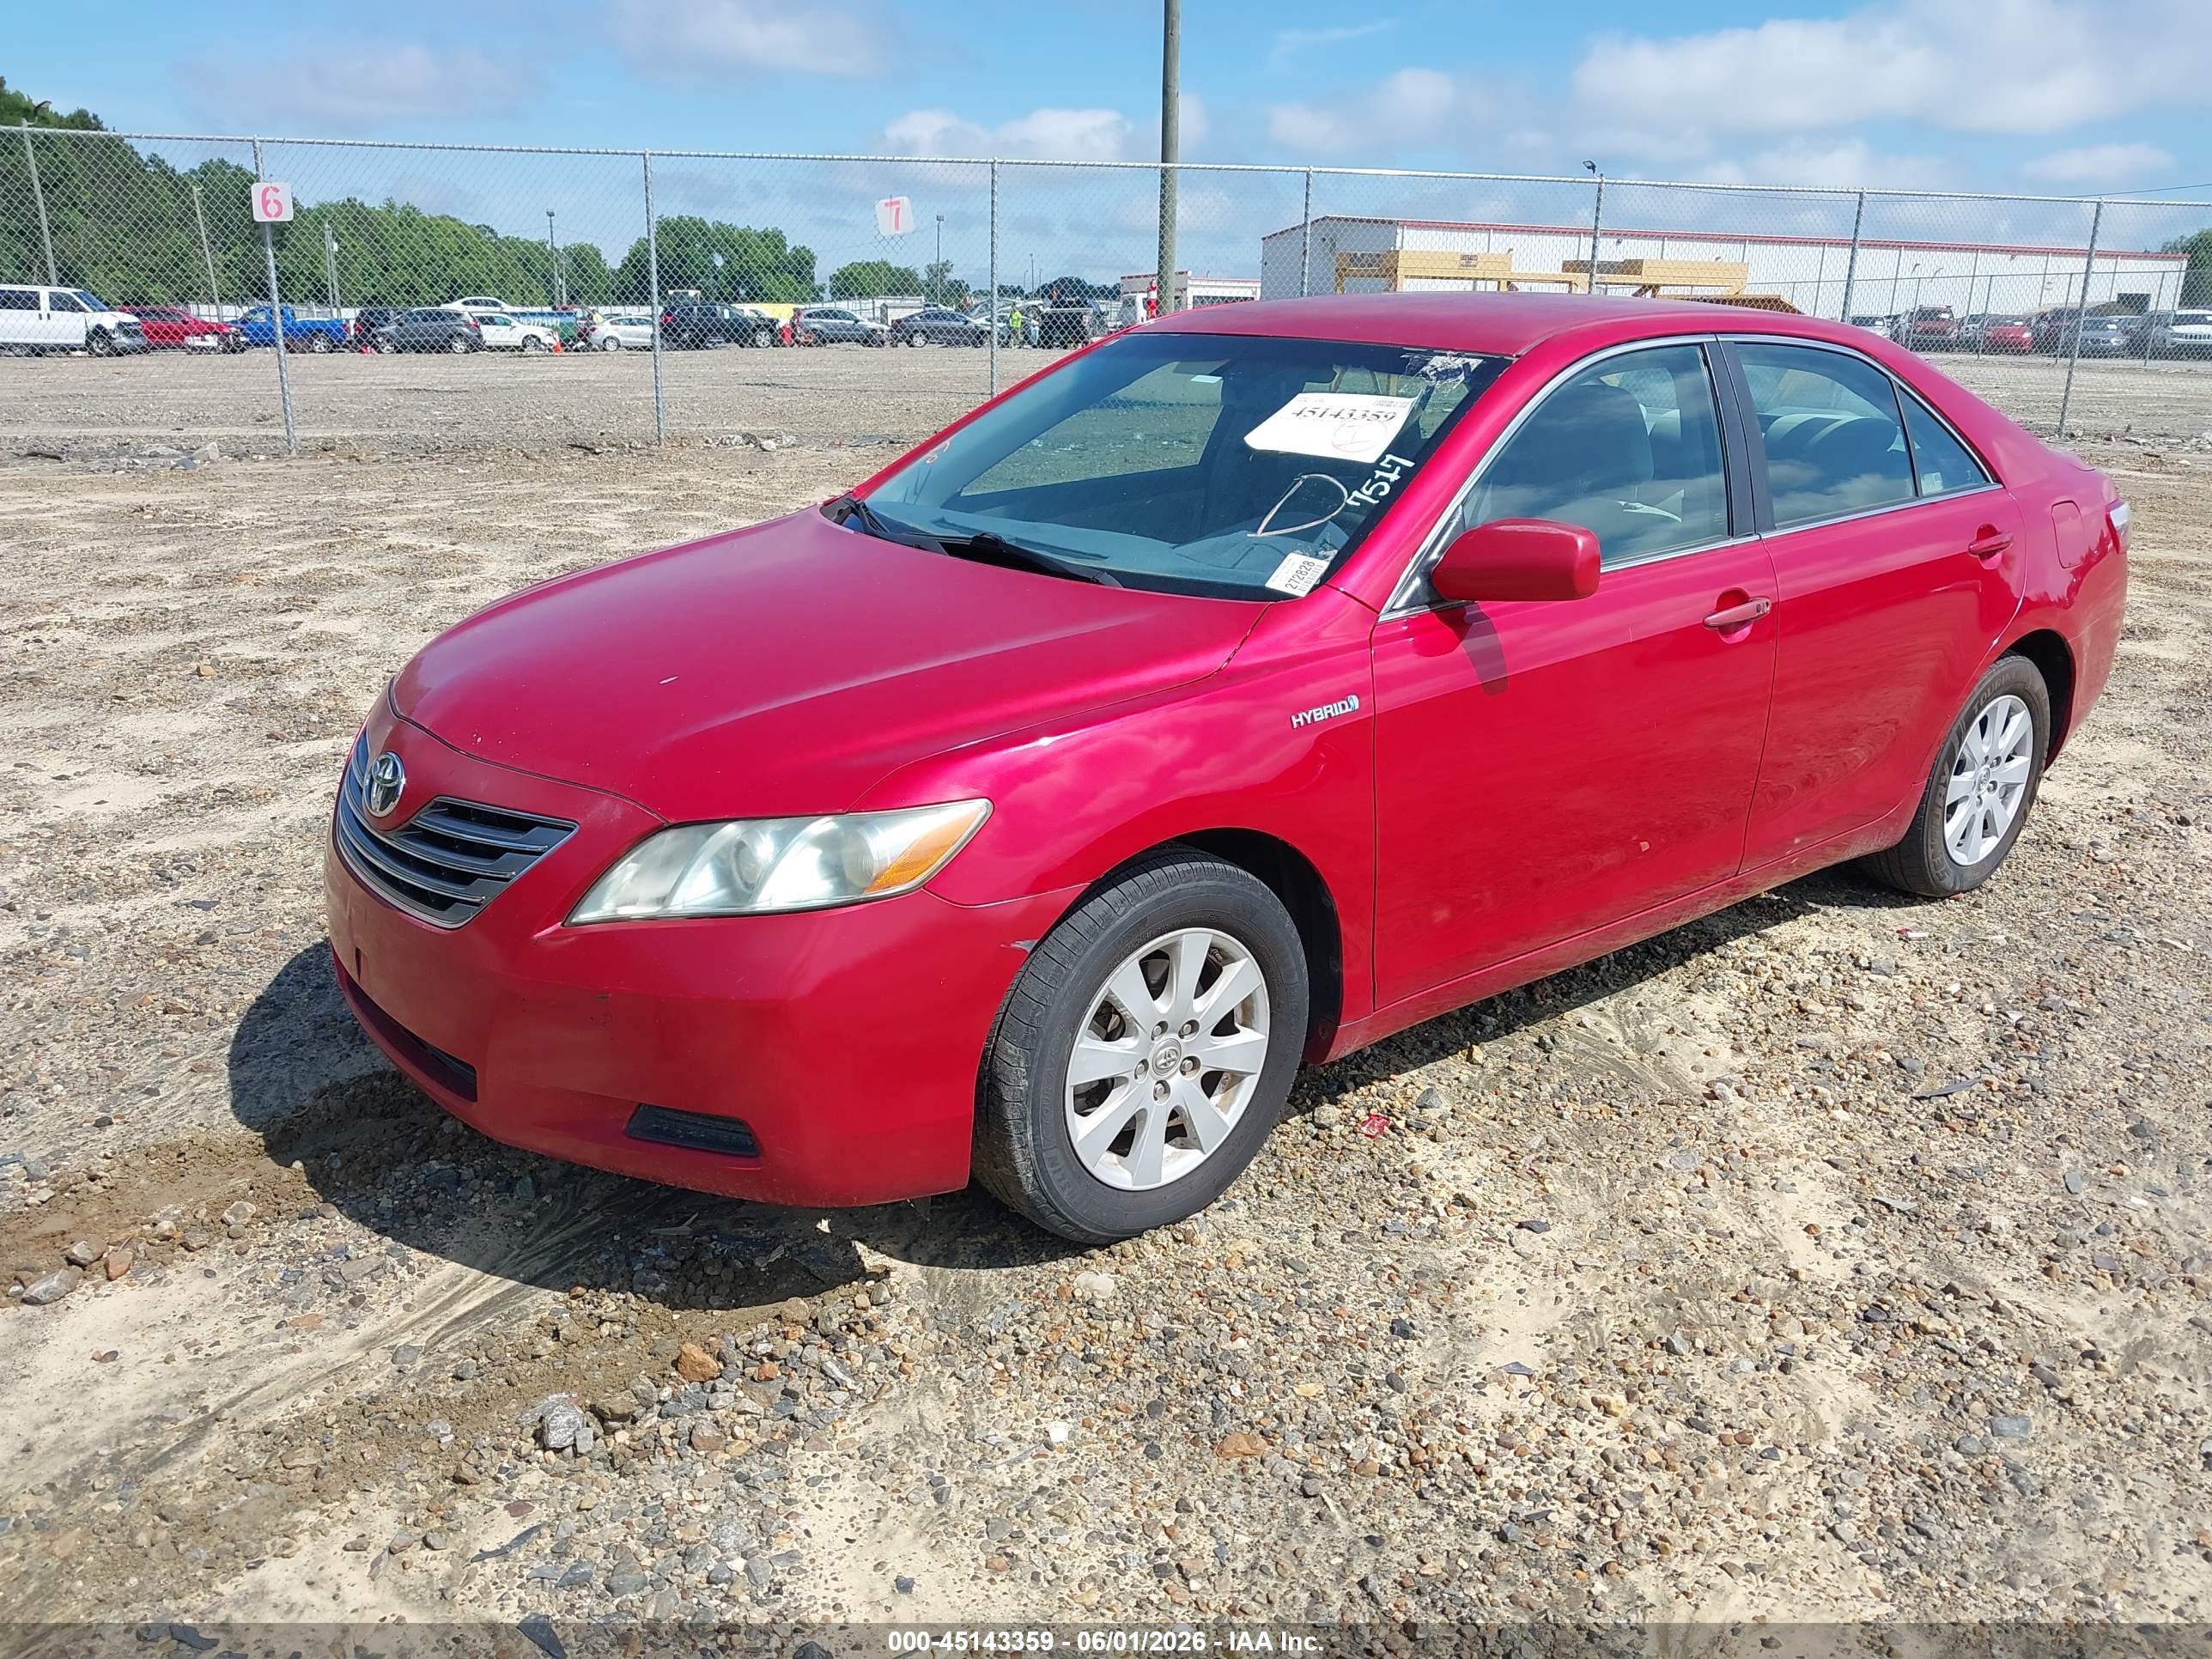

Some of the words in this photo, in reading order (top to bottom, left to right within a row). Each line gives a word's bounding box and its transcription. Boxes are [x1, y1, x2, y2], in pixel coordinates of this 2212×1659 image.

[261, 185, 283, 218] 6
[884, 200, 901, 232] 7
[1291, 407, 1397, 422] 45143359
[1285, 561, 1315, 590] 272828
[1291, 700, 1352, 729] HYBRID
